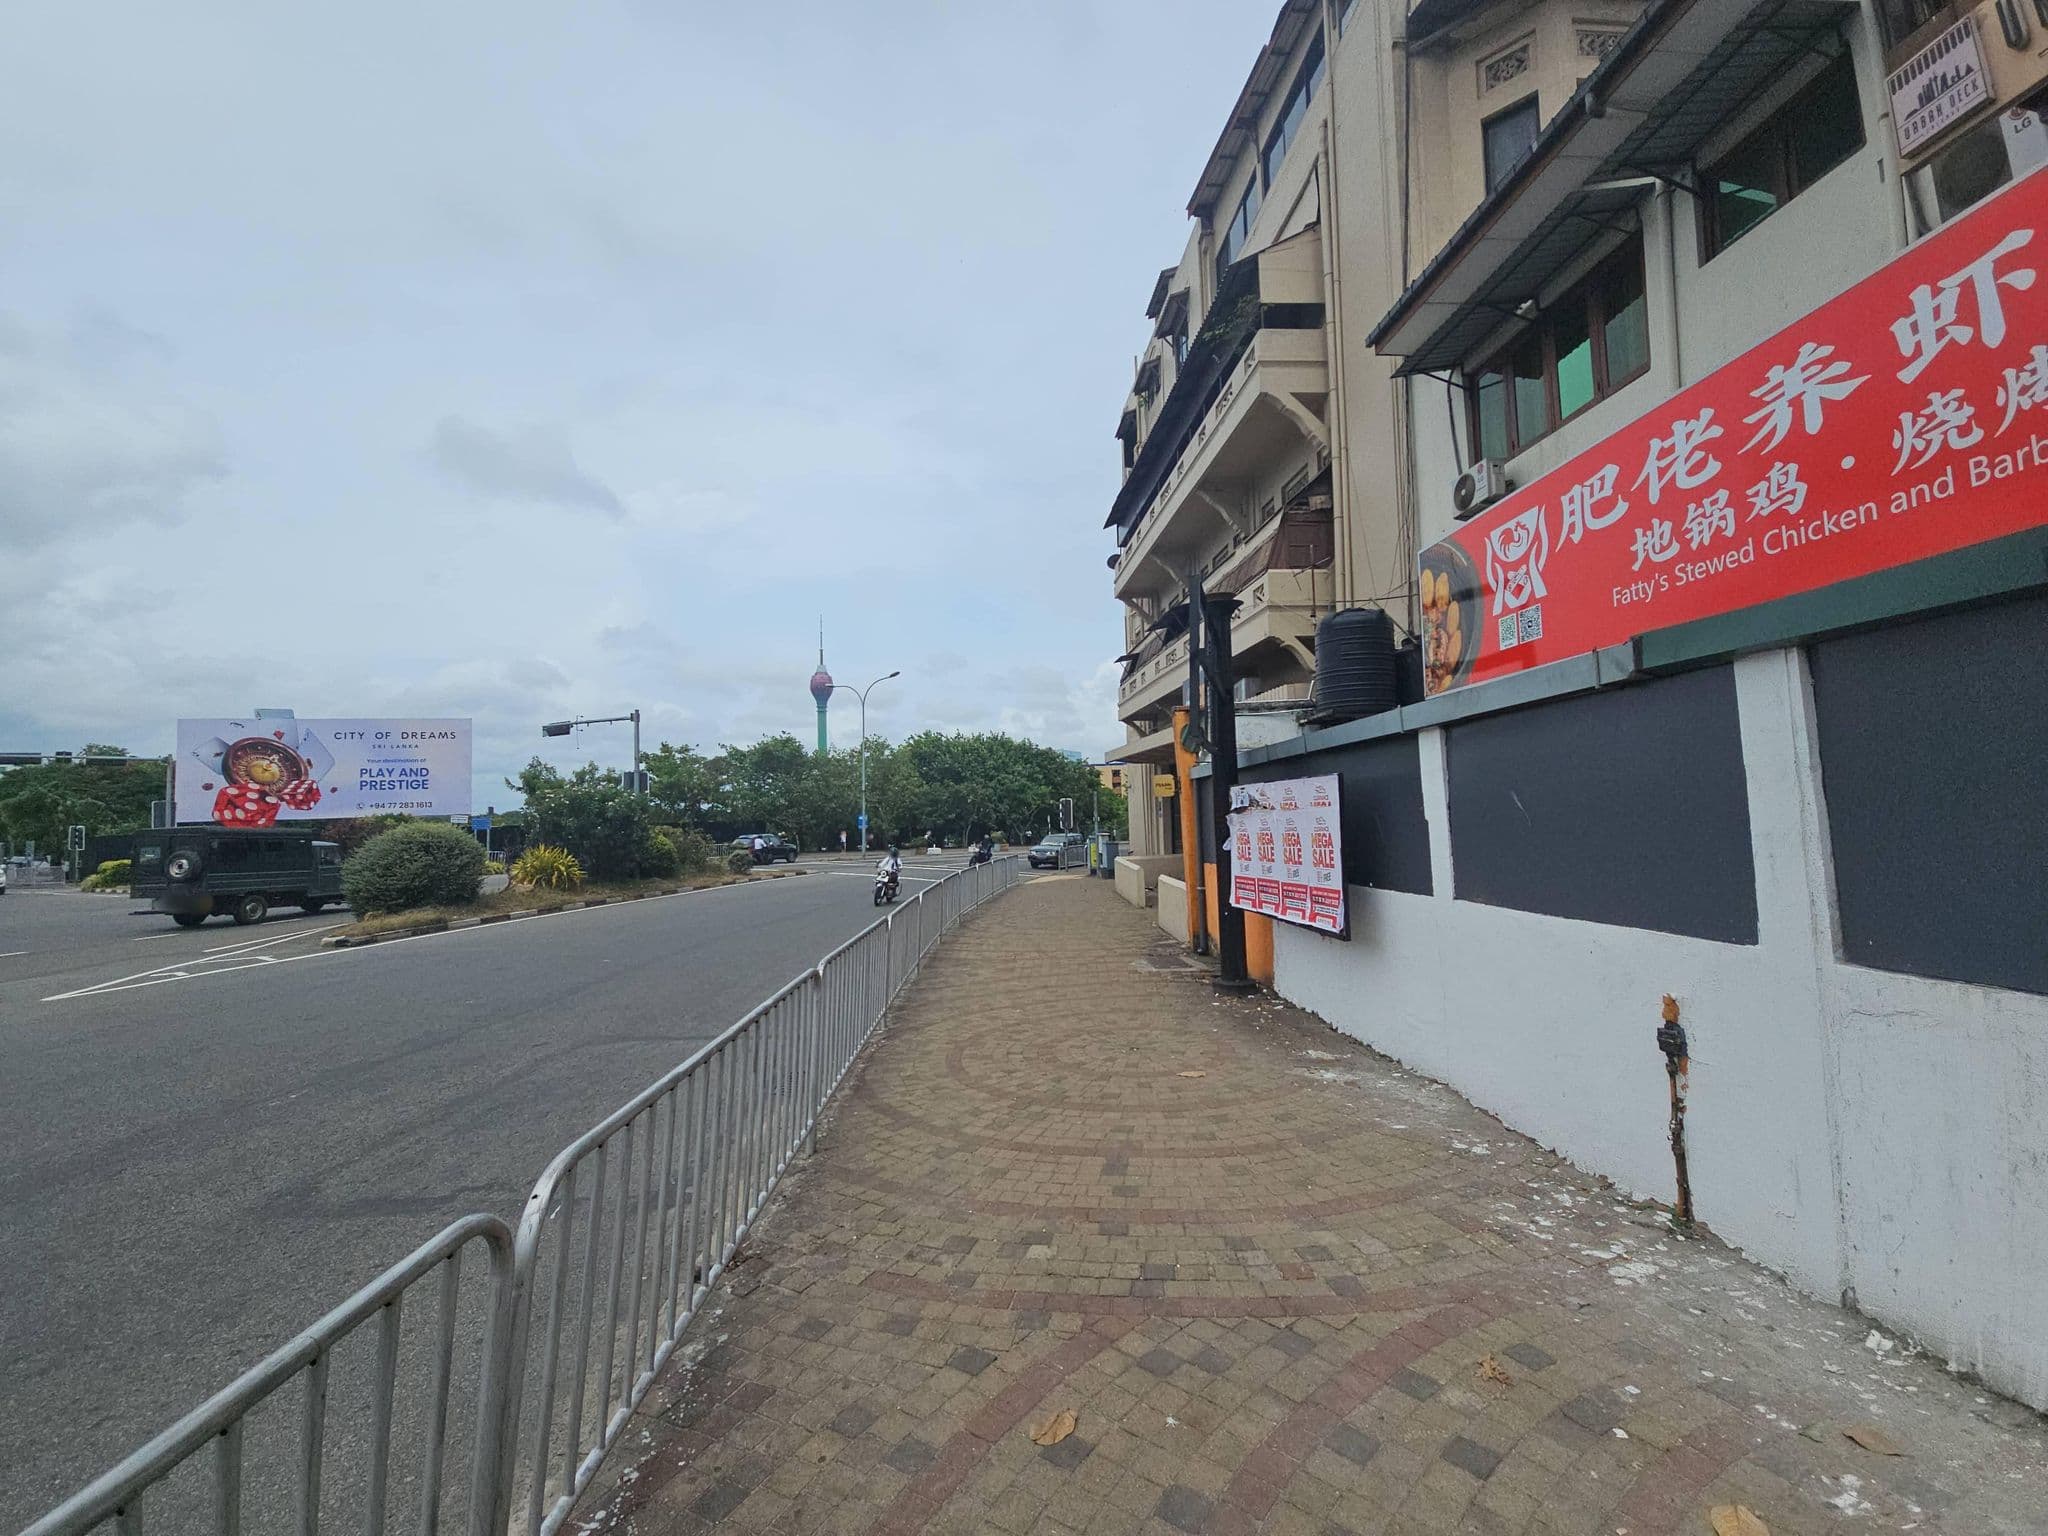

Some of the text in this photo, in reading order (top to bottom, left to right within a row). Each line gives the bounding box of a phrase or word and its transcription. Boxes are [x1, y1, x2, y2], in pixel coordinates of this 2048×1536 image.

[1904, 103, 1943, 140] URBAN
[1949, 78, 1979, 108] DECK
[2014, 116, 2032, 134] LG
[1612, 573, 1669, 608] Fatty's
[1674, 537, 1755, 586] Stewed
[1763, 501, 1878, 555] Chicken
[1890, 465, 1955, 514] and
[334, 731, 457, 740] CITY OF DREAMS
[359, 767, 430, 778] PLAY AND
[359, 779, 430, 791] PRESTIGE
[416, 801, 433, 809] 1613
[1257, 831, 1275, 846] MEGA
[1282, 832, 1302, 848] MEGA
[1311, 832, 1334, 849] MEGA
[1258, 845, 1276, 863] SALE
[1283, 847, 1303, 866] SALE
[1312, 848, 1336, 869] SALE
